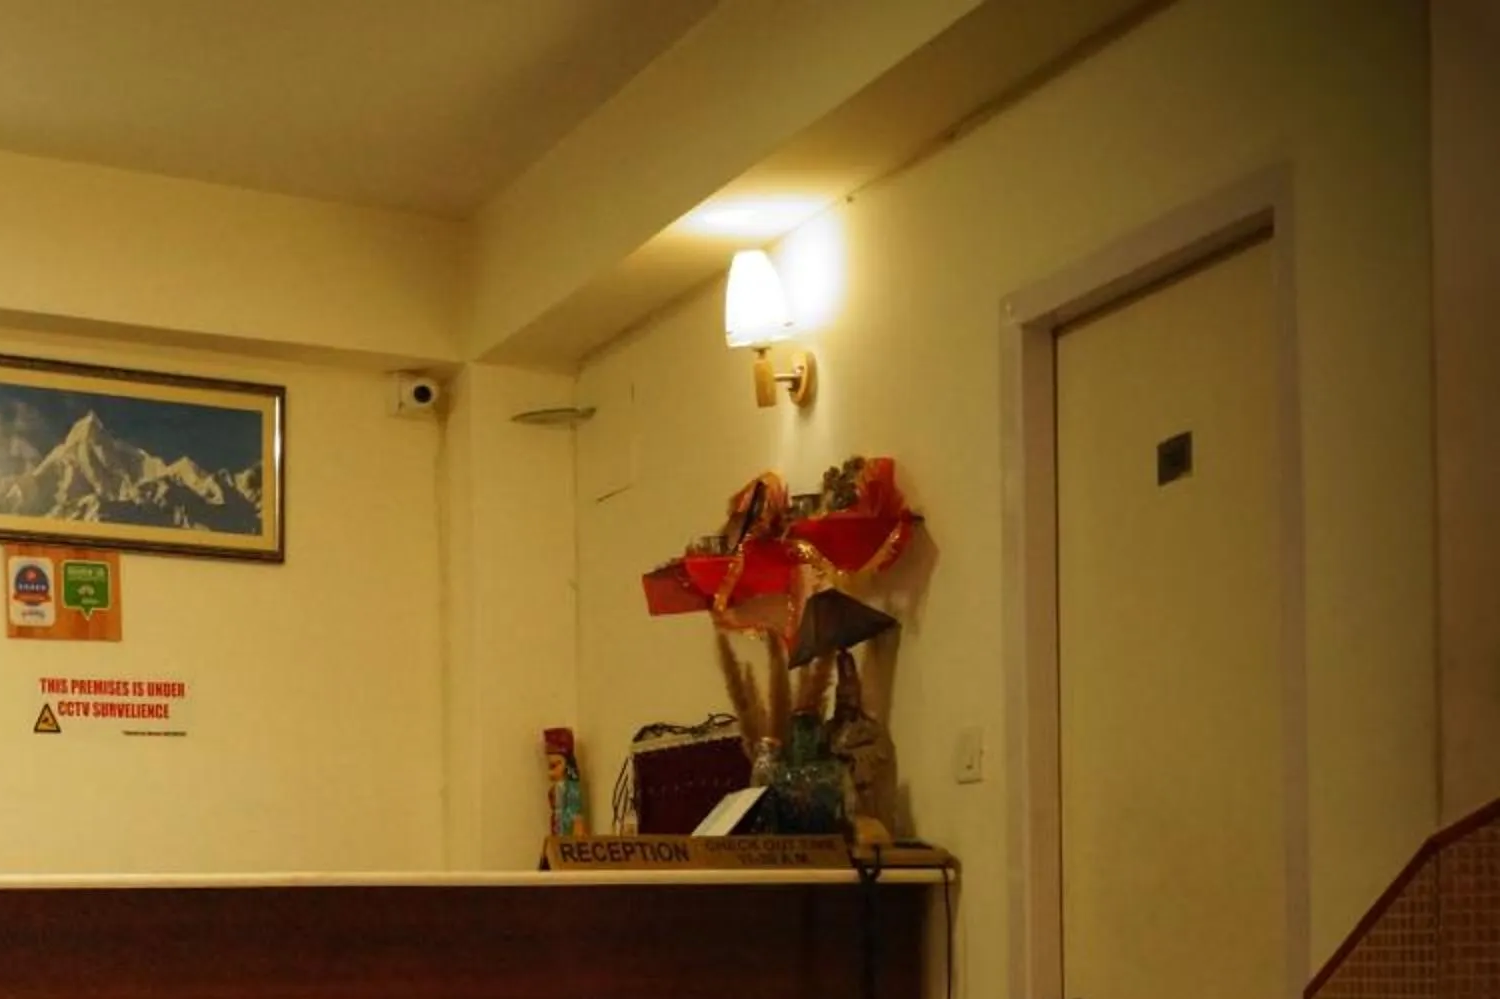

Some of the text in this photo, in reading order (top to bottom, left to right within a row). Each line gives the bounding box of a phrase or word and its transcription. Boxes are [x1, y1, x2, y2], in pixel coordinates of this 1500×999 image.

[40, 678, 185, 698] THIS PREMISES IS UNDER
[57, 701, 169, 719] CCTV SURVELIENCE
[560, 842, 690, 862] RECEPTION
